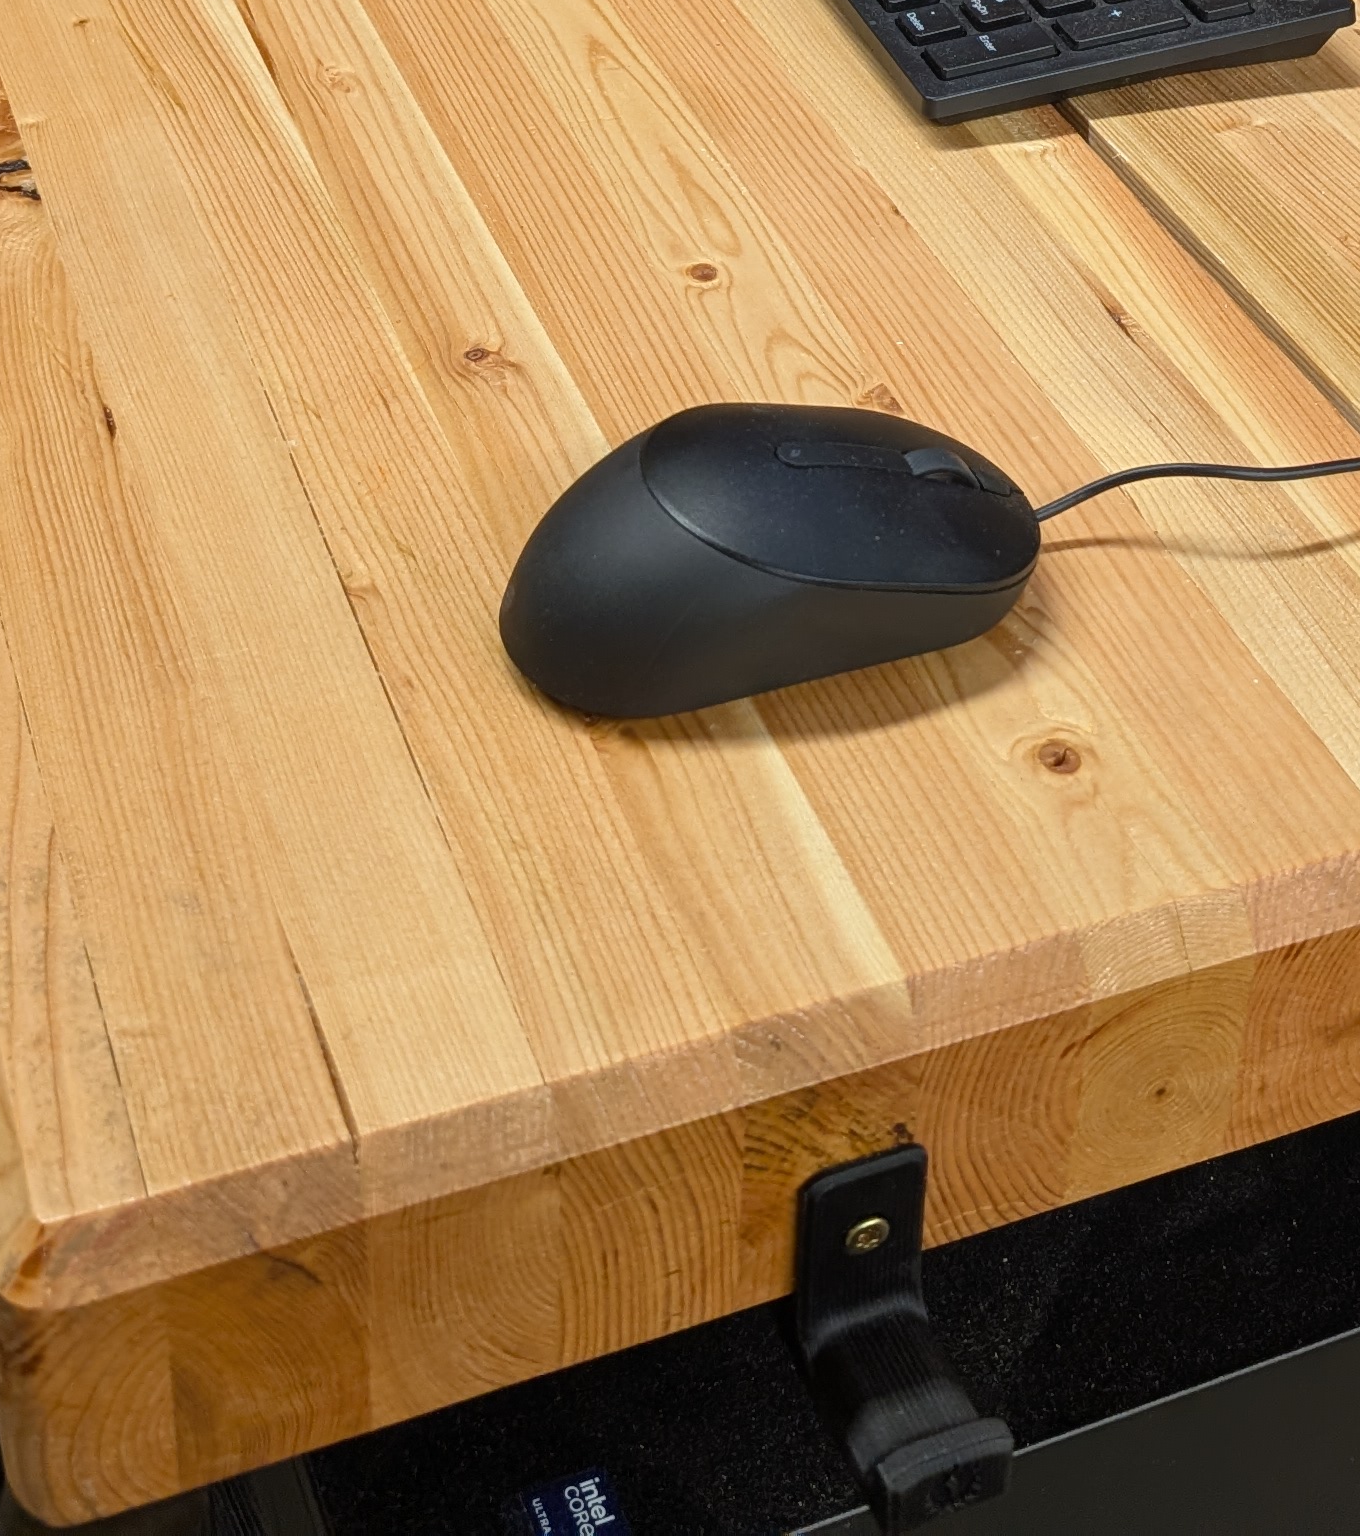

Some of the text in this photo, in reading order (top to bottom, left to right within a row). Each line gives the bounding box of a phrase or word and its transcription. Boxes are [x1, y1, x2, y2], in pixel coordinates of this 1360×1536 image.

[971, 0, 988, 15] PgDn
[907, 12, 924, 30] Delete
[979, 35, 996, 51] Enter
[579, 1477, 616, 1525] intel
[532, 1497, 552, 1536] ULTRA
